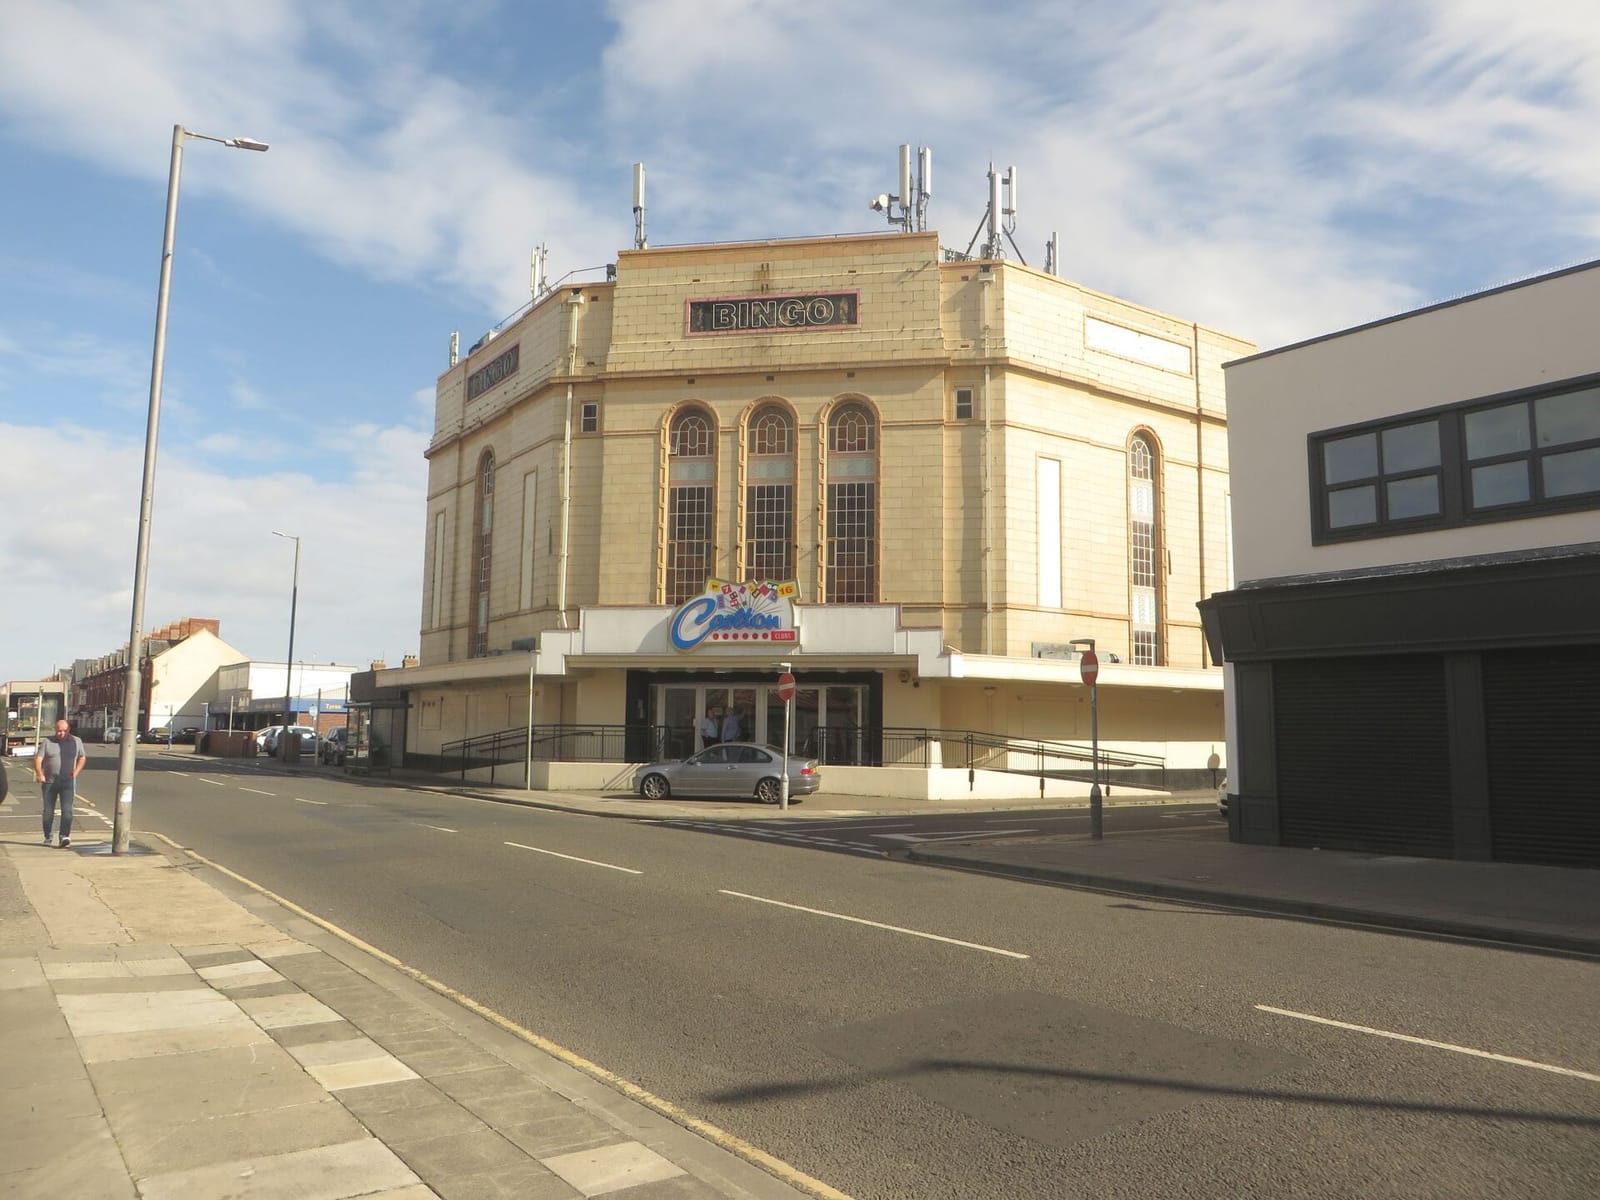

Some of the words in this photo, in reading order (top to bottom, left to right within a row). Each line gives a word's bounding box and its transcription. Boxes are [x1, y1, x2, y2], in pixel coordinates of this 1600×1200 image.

[712, 297, 835, 330] BINGO
[472, 351, 513, 397] BINGO
[671, 597, 781, 650] Carlton
